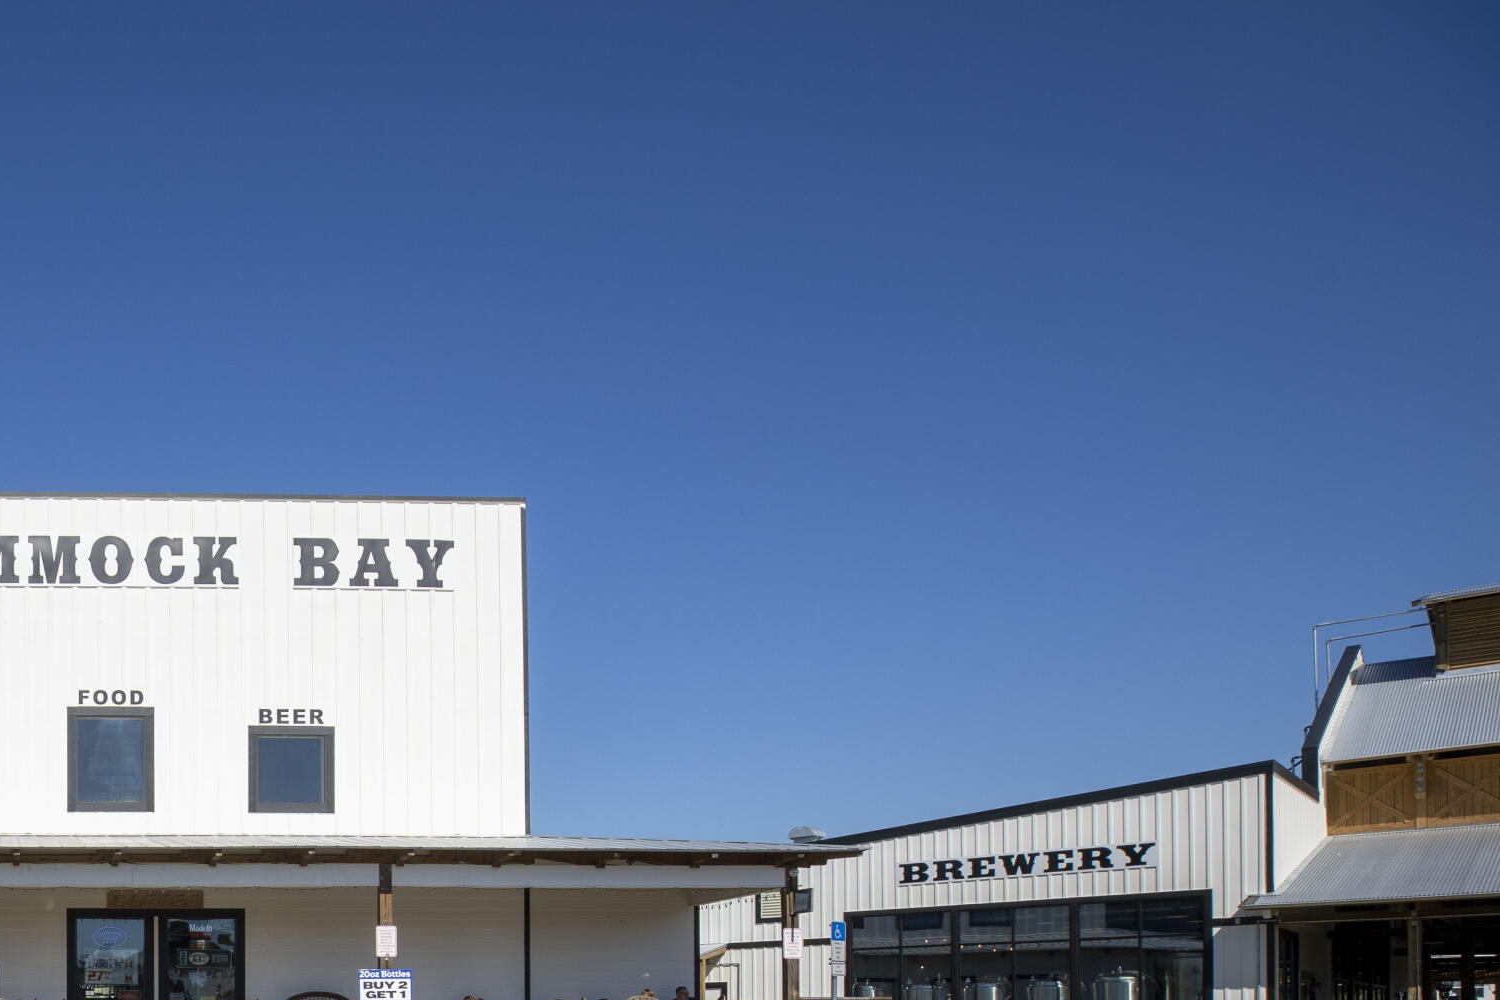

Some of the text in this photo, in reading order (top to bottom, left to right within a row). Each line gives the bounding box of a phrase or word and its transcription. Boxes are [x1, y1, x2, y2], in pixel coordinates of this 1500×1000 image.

[292, 537, 455, 588] BAY
[78, 690, 145, 705] FOOD
[258, 708, 325, 725] BEER
[898, 842, 1156, 885] BREWERY
[363, 981, 408, 989] BUY 2
[365, 991, 396, 999] GET
